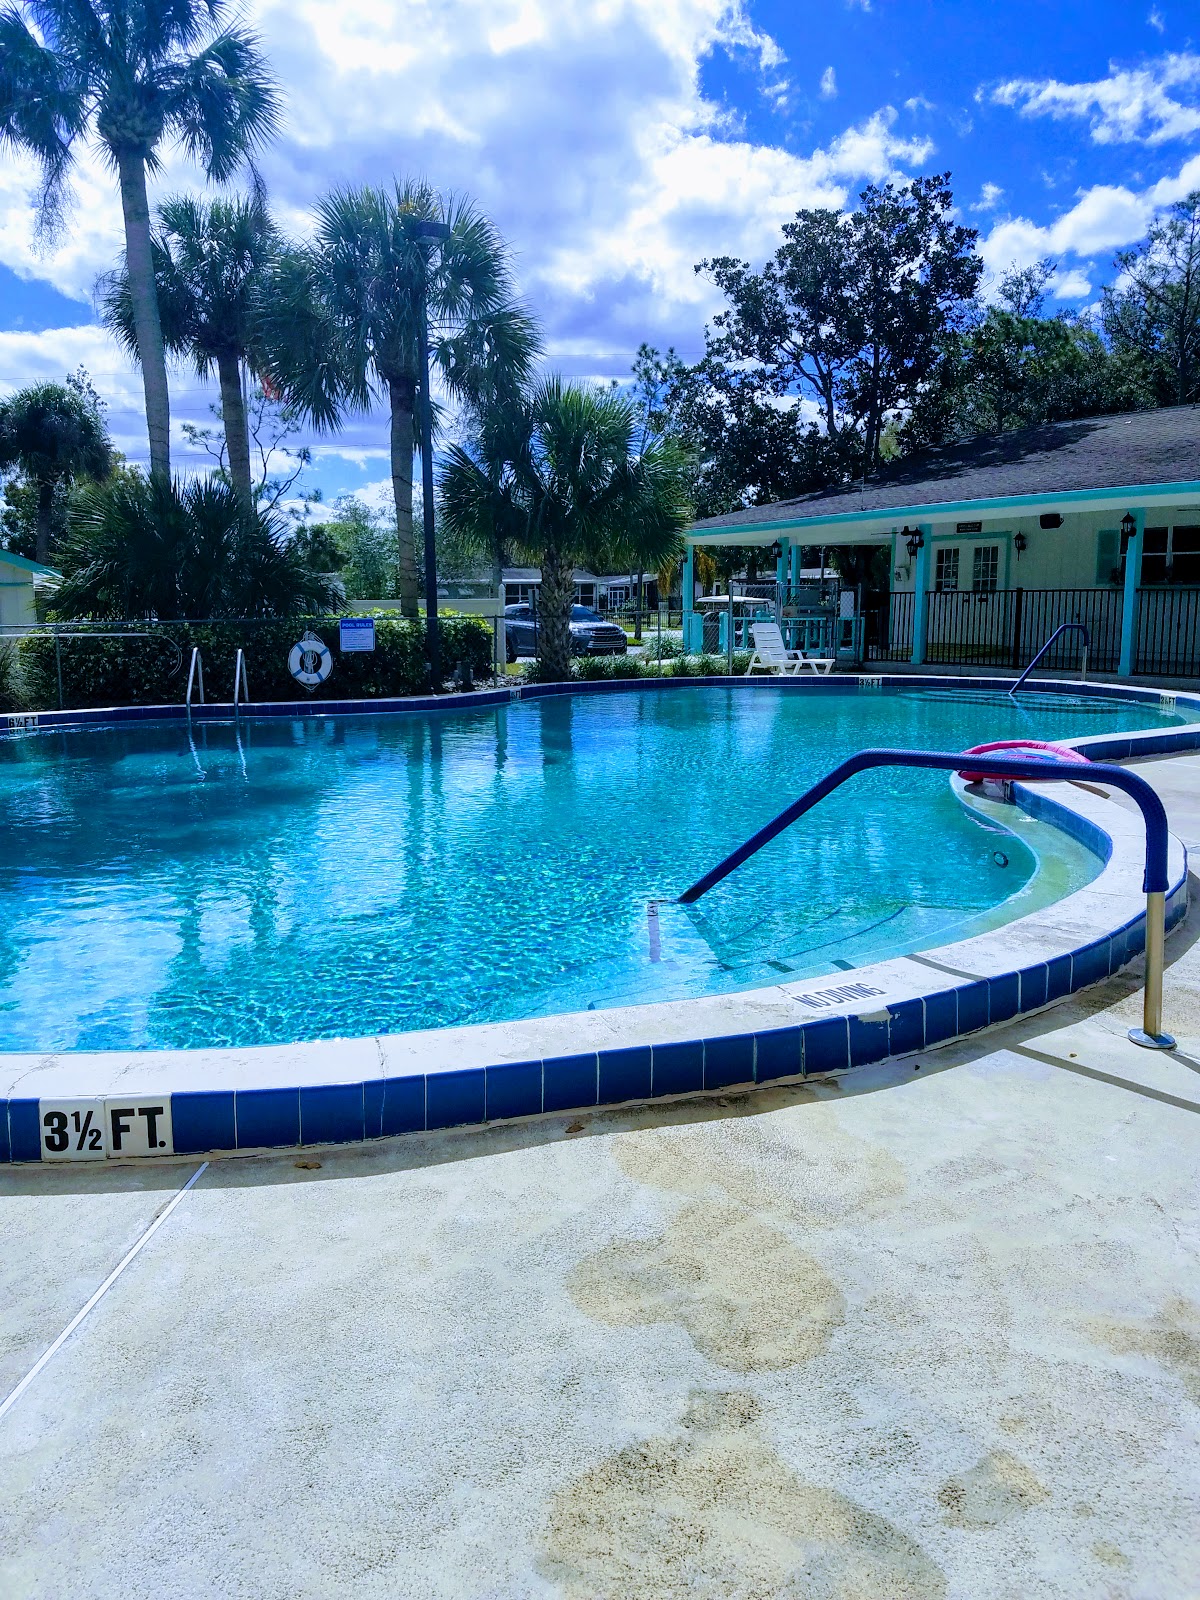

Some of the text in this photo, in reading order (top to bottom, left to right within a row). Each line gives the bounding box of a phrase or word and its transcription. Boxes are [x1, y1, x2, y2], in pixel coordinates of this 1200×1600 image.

[791, 983, 887, 1008] NO DIVING
[110, 1106, 167, 1150] FT.
